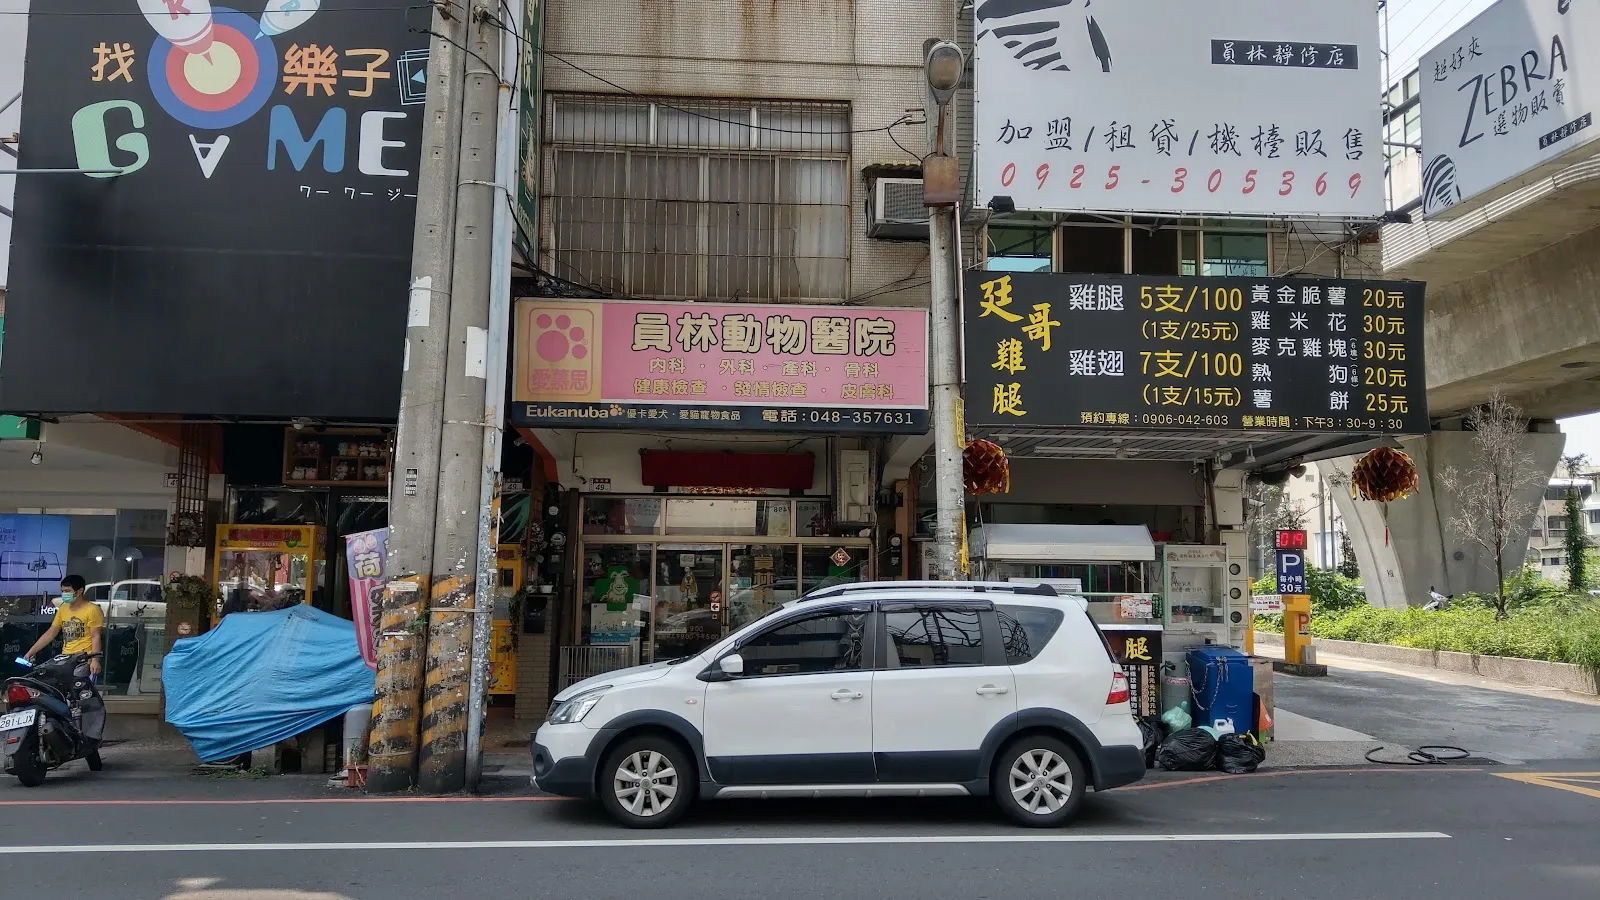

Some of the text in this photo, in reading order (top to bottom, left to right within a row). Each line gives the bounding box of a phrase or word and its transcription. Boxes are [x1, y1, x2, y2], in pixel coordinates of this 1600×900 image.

[1221, 42, 1345, 67] 員林靜修店
[283, 43, 391, 97] 樂子
[1457, 34, 1568, 149] ZEBRA
[1000, 161, 1363, 200] 0925-305369
[1069, 284, 1243, 313] 雞腿 5支/100
[1362, 290, 1405, 309] 20元
[631, 312, 896, 356] 員林動物醫院
[1141, 320, 1240, 342] (1支/25元)
[1363, 315, 1406, 335] 30元
[1252, 337, 1348, 358] 麥克雞塊
[1363, 340, 1406, 361] 30元
[718, 359, 756, 375] 外科
[781, 360, 818, 377] 產科
[844, 362, 880, 378] 骨科
[1069, 348, 1243, 377] 雞翅 7支/100
[531, 368, 590, 391] 愛慕思
[1364, 366, 1407, 387] 20元
[633, 378, 895, 399] 健康檢查 發情檢查 皮膚科
[1142, 386, 1243, 407] (1支/15元)
[526, 404, 609, 419] Eukanuba
[1366, 393, 1409, 414] 25元
[1281, 553, 1301, 574] P
[1280, 575, 1302, 583] 每小時
[1280, 584, 1303, 593] 30元
[1299, 613, 1310, 631] P
[1126, 637, 1153, 661] 腿
